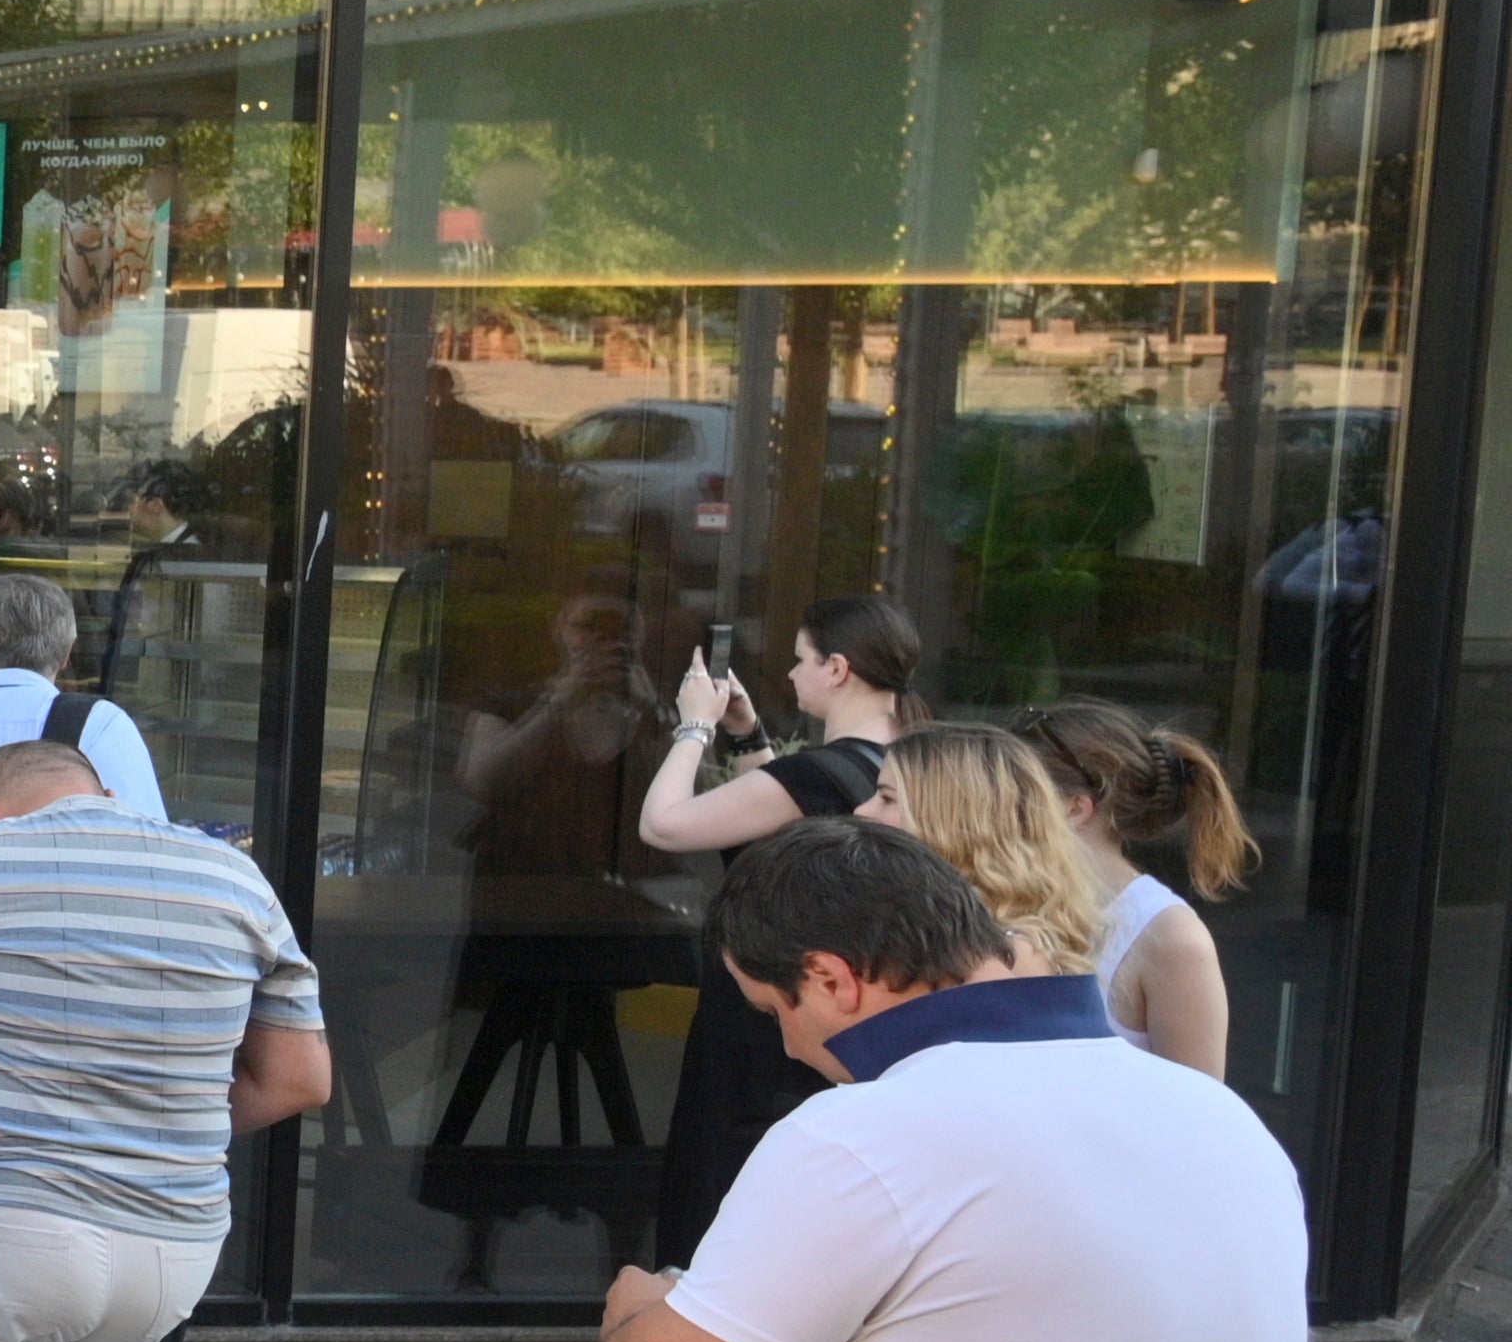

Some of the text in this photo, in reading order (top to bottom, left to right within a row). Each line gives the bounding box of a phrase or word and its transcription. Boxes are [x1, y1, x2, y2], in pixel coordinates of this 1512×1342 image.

[21, 135, 166, 151] ЛУЧШЕ, ЧЕМ БЫЛО
